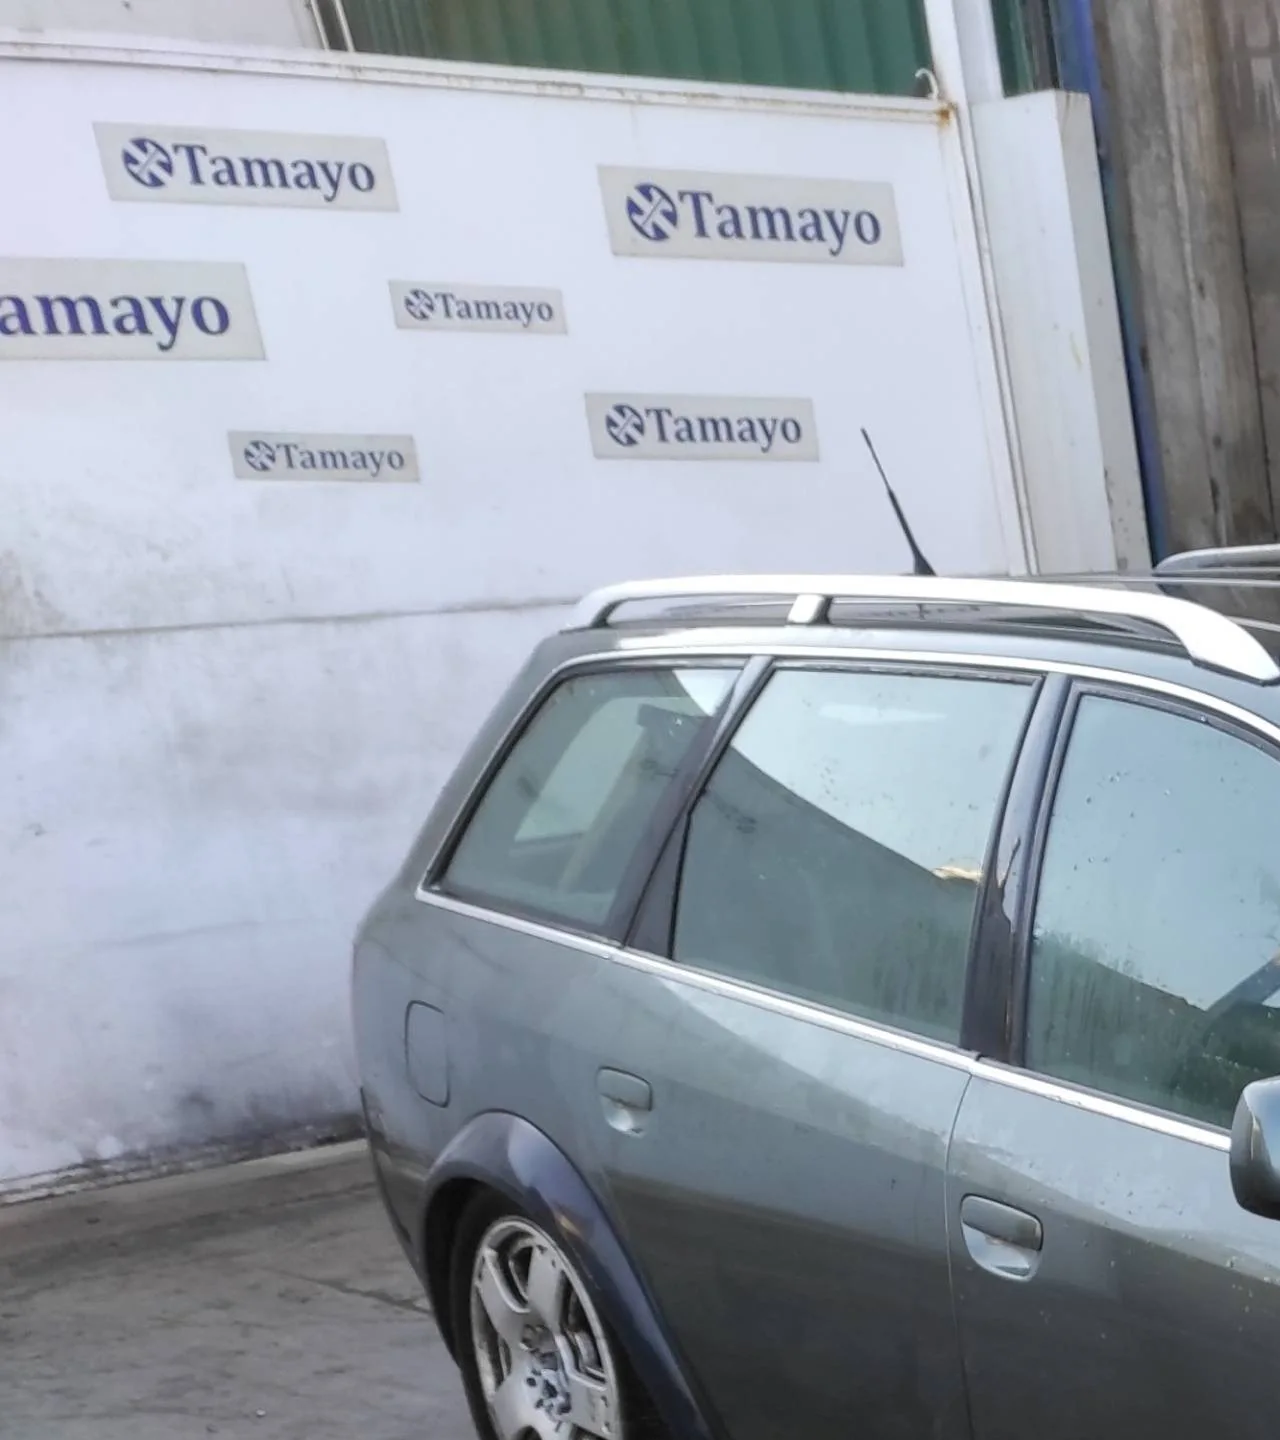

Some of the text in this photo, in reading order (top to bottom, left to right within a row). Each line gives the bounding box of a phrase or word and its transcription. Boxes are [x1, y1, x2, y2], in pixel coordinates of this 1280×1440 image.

[173, 144, 375, 202] Tamayo
[678, 191, 880, 256] Tamayo
[0, 296, 230, 352] amayo
[432, 293, 553, 328] Tamayo
[645, 408, 801, 453] Tamayo
[276, 444, 404, 477] Tamayo
